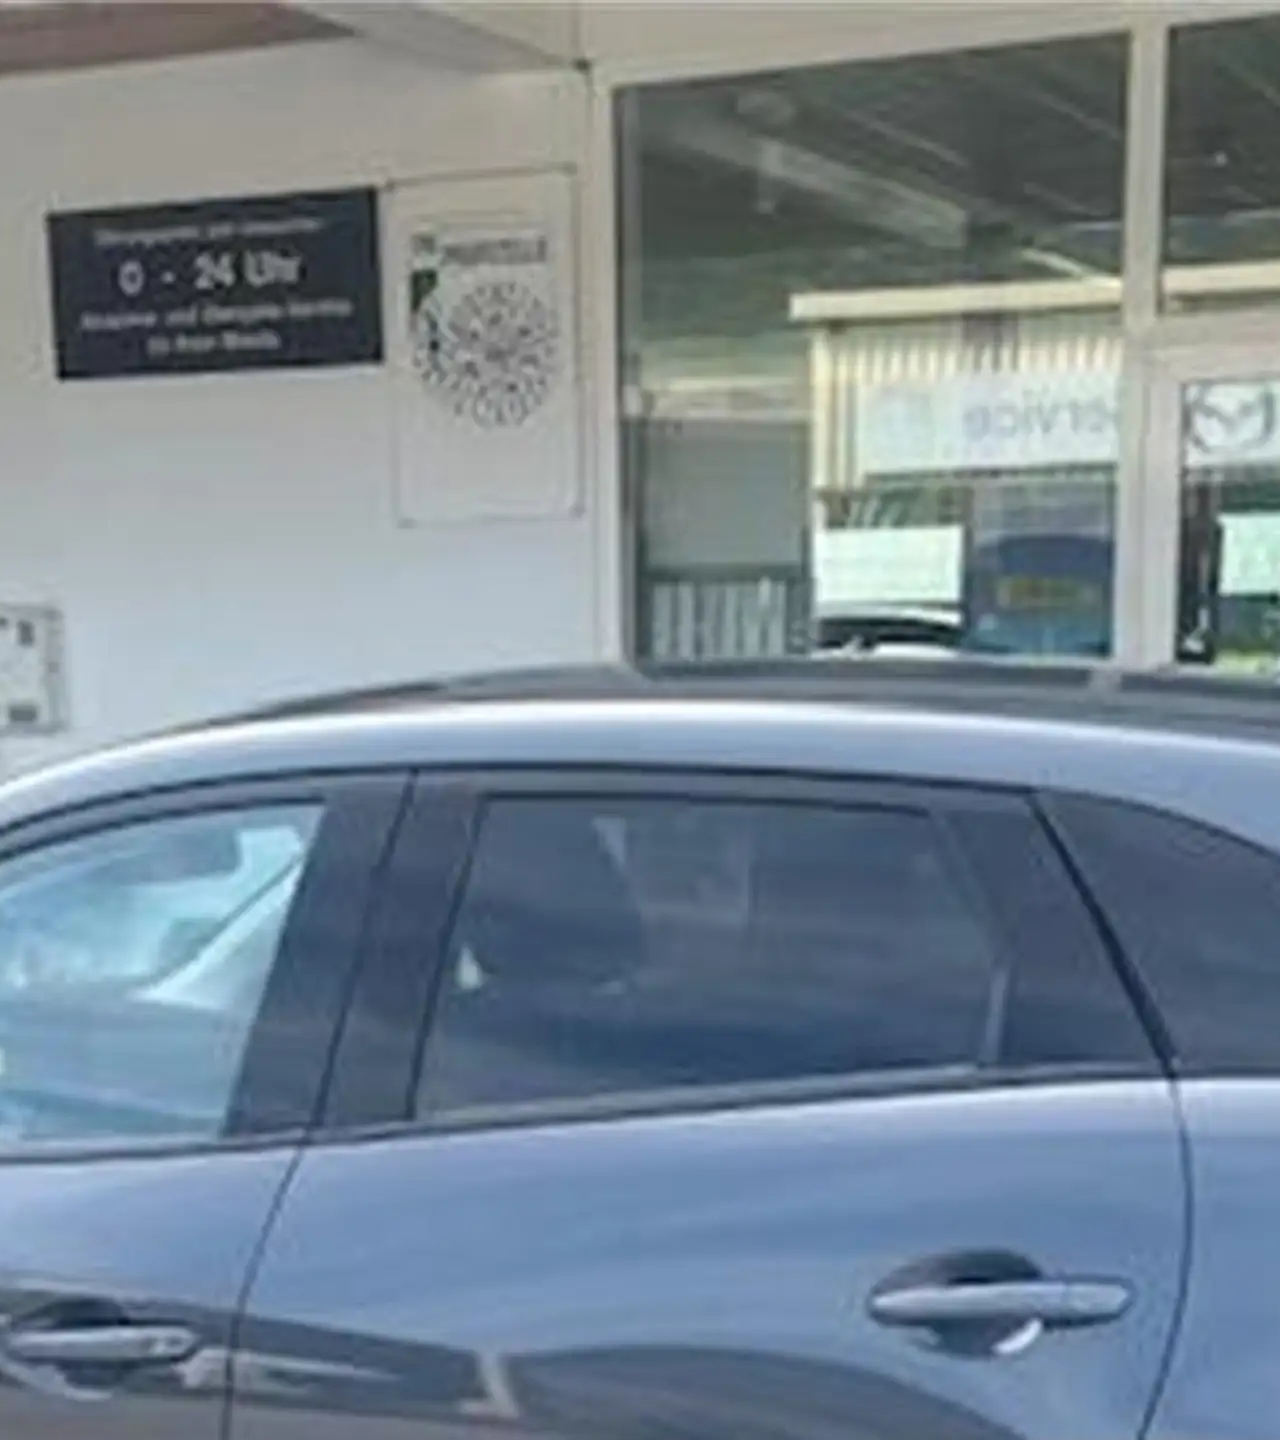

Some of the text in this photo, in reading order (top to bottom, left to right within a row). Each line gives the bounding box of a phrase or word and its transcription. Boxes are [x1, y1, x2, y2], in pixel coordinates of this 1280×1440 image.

[118, 259, 145, 296] 0
[195, 252, 237, 289] 24
[243, 250, 301, 288] Uhr
